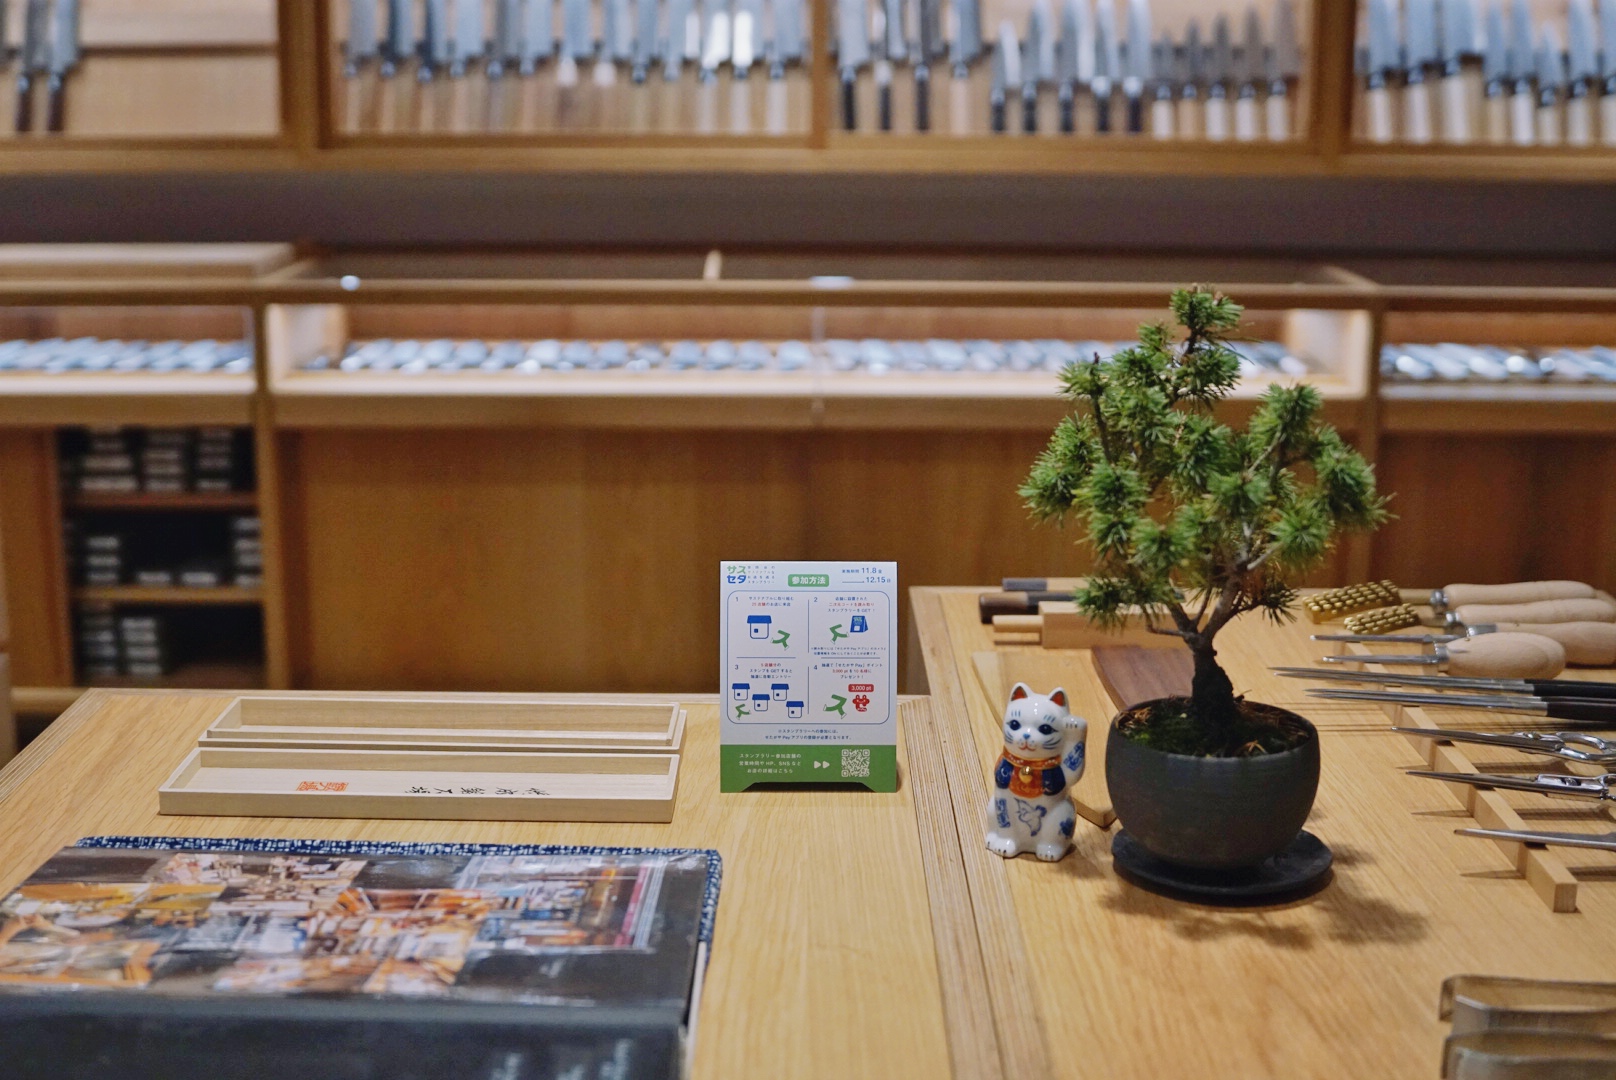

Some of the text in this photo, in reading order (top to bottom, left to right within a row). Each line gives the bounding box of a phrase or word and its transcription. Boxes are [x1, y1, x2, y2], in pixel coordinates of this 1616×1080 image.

[727, 566, 746, 574] サス
[727, 575, 746, 584] セタ
[792, 576, 826, 584] 参加方法
